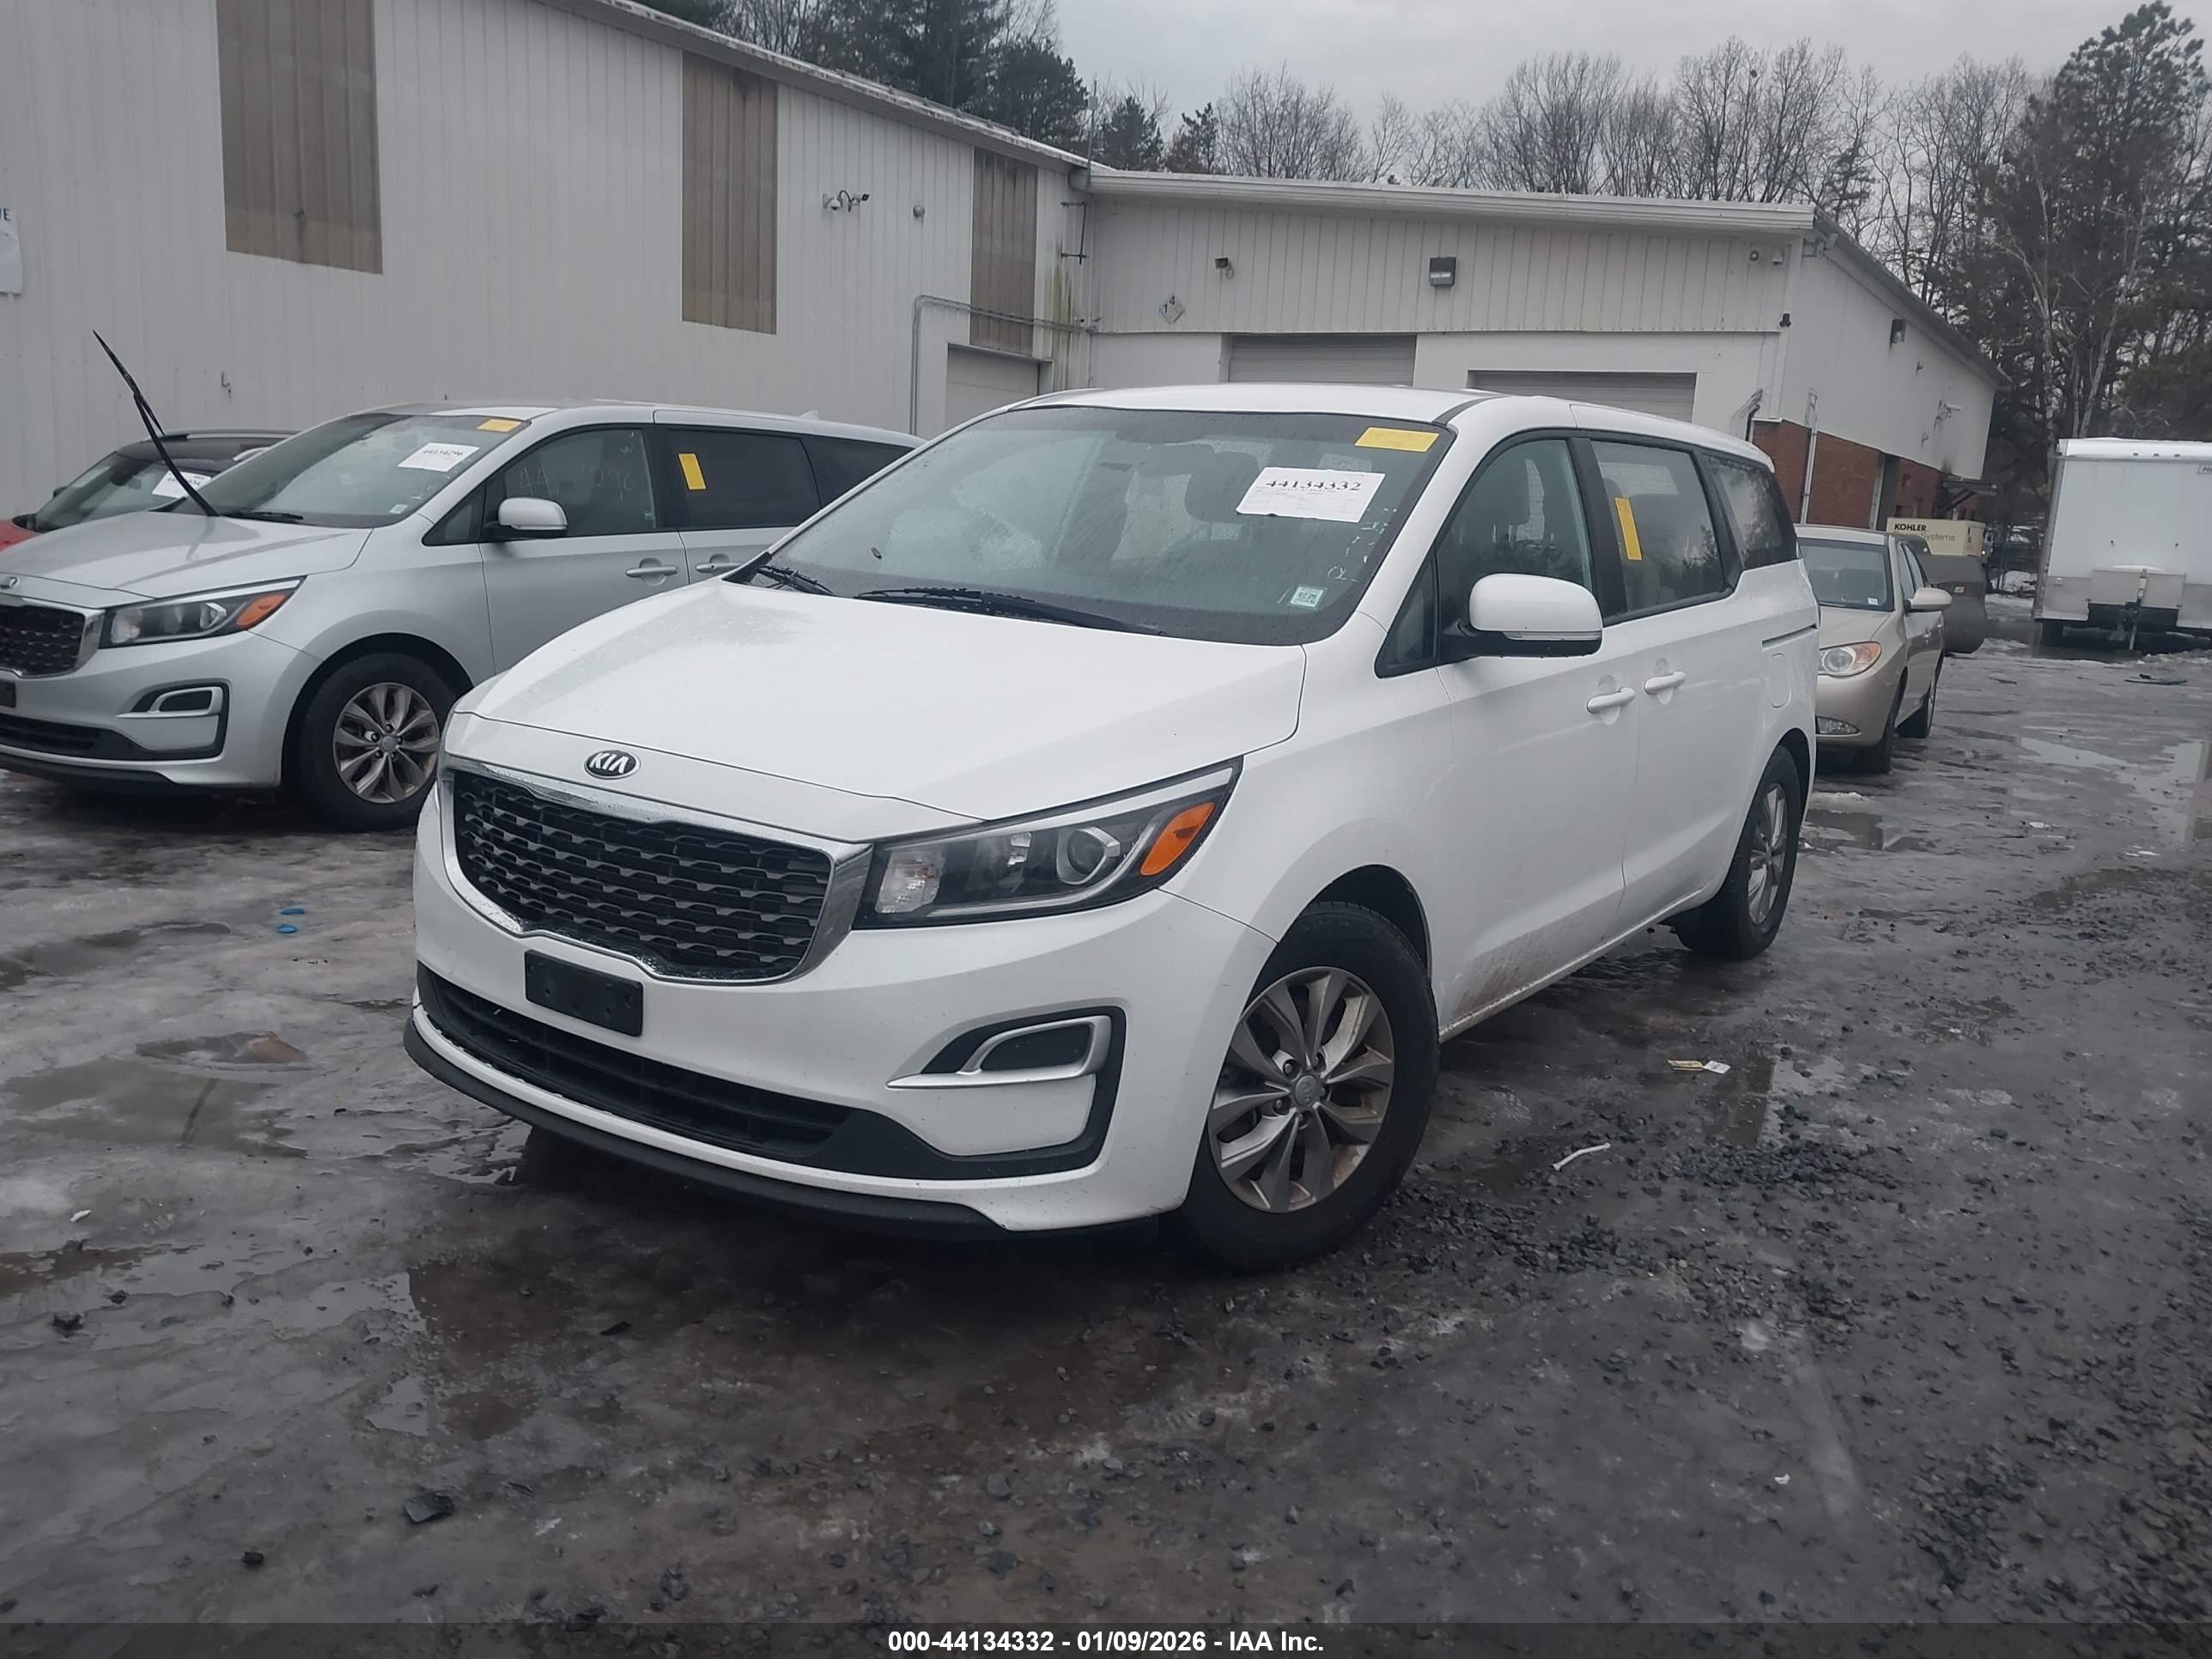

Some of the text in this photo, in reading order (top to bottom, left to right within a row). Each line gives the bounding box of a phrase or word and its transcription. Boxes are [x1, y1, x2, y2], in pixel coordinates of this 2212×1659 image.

[1169, 295, 1176, 306] 4
[1163, 303, 1168, 313] 1
[1266, 480, 1362, 491] 44134332
[588, 752, 629, 774] KIA
